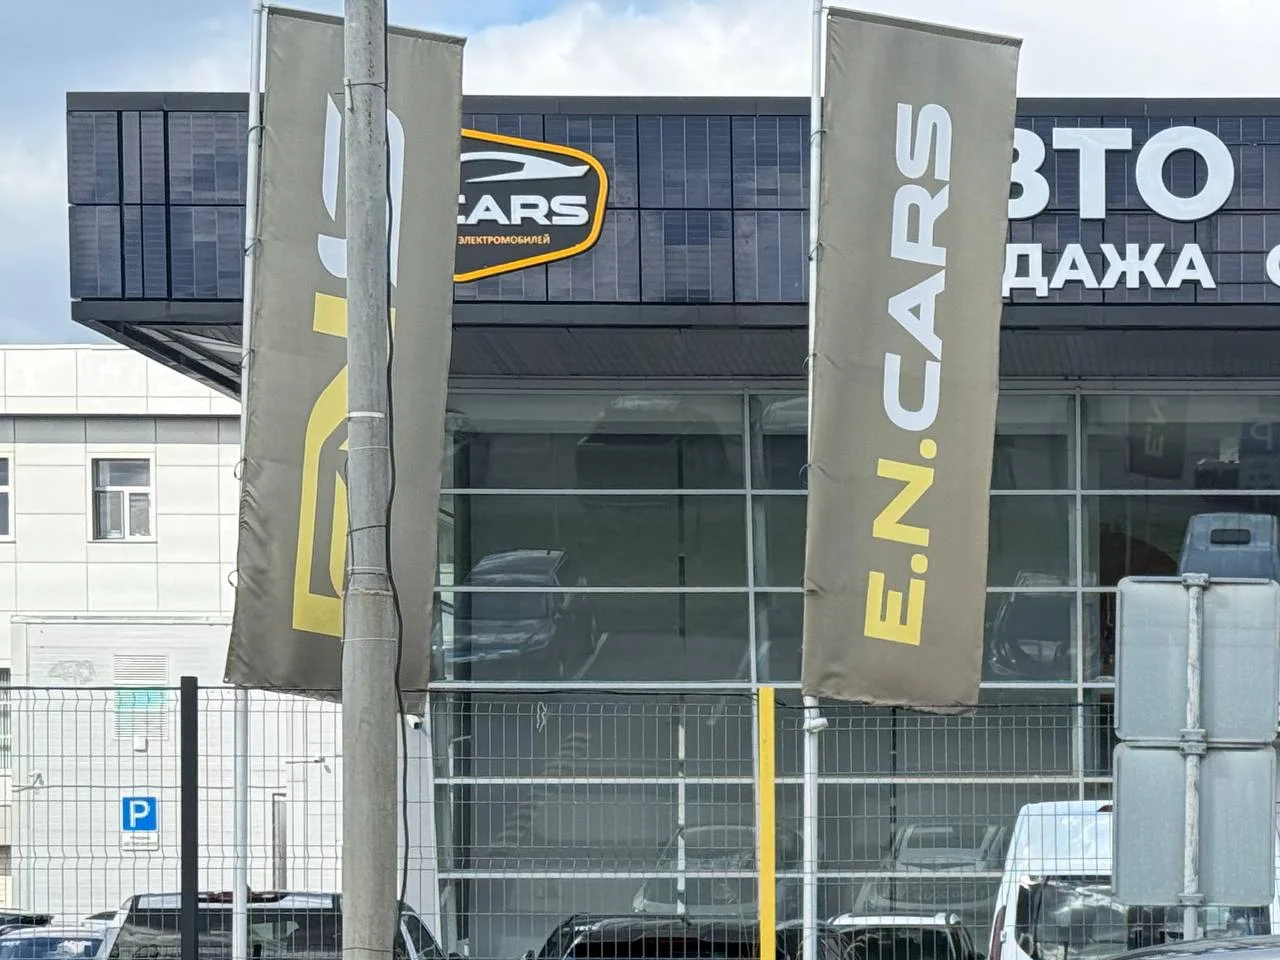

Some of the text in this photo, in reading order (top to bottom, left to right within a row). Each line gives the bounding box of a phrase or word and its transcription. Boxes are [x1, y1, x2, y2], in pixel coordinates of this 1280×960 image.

[457, 194, 589, 226] ARS
[458, 233, 551, 245] ЭЛЕКТРОМОБИЛЕЙ
[863, 101, 953, 647] E.N.CARS
[129, 799, 151, 828] P
